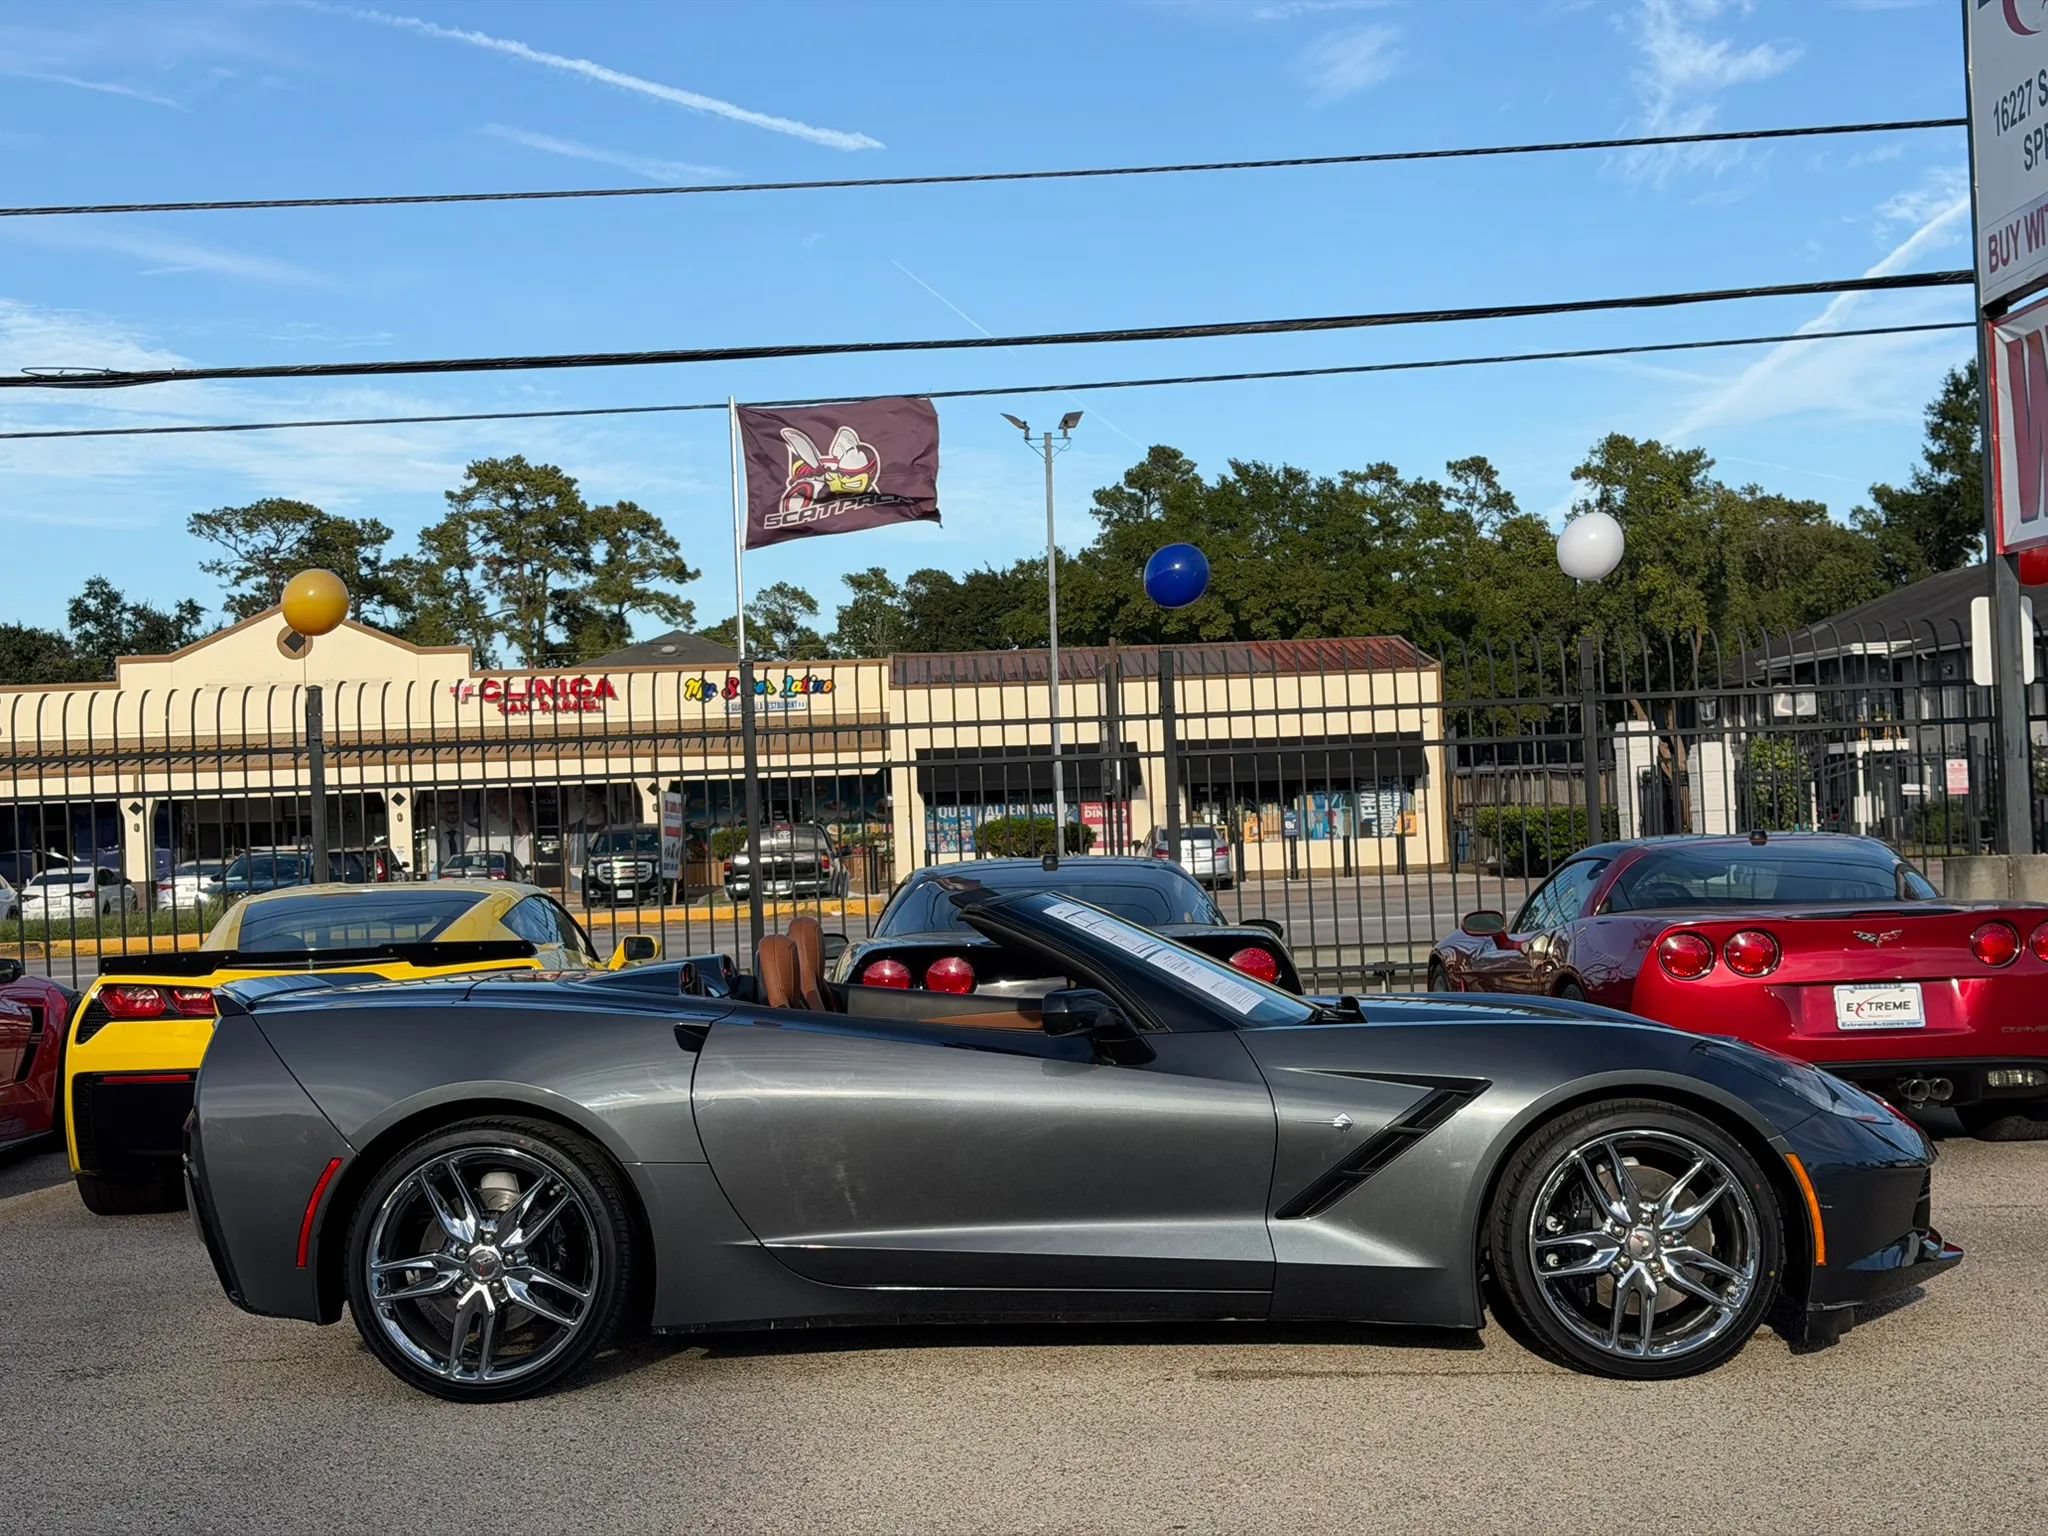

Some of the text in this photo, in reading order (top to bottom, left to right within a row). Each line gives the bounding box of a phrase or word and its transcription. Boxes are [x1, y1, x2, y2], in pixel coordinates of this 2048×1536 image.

[1994, 78, 2033, 137] 16227
[1988, 219, 2021, 274] BUY
[482, 677, 617, 703] CLINICA
[780, 674, 836, 698] Latino
[1846, 1000, 1912, 1013] EXTREME
[531, 1143, 564, 1168] GRAND
